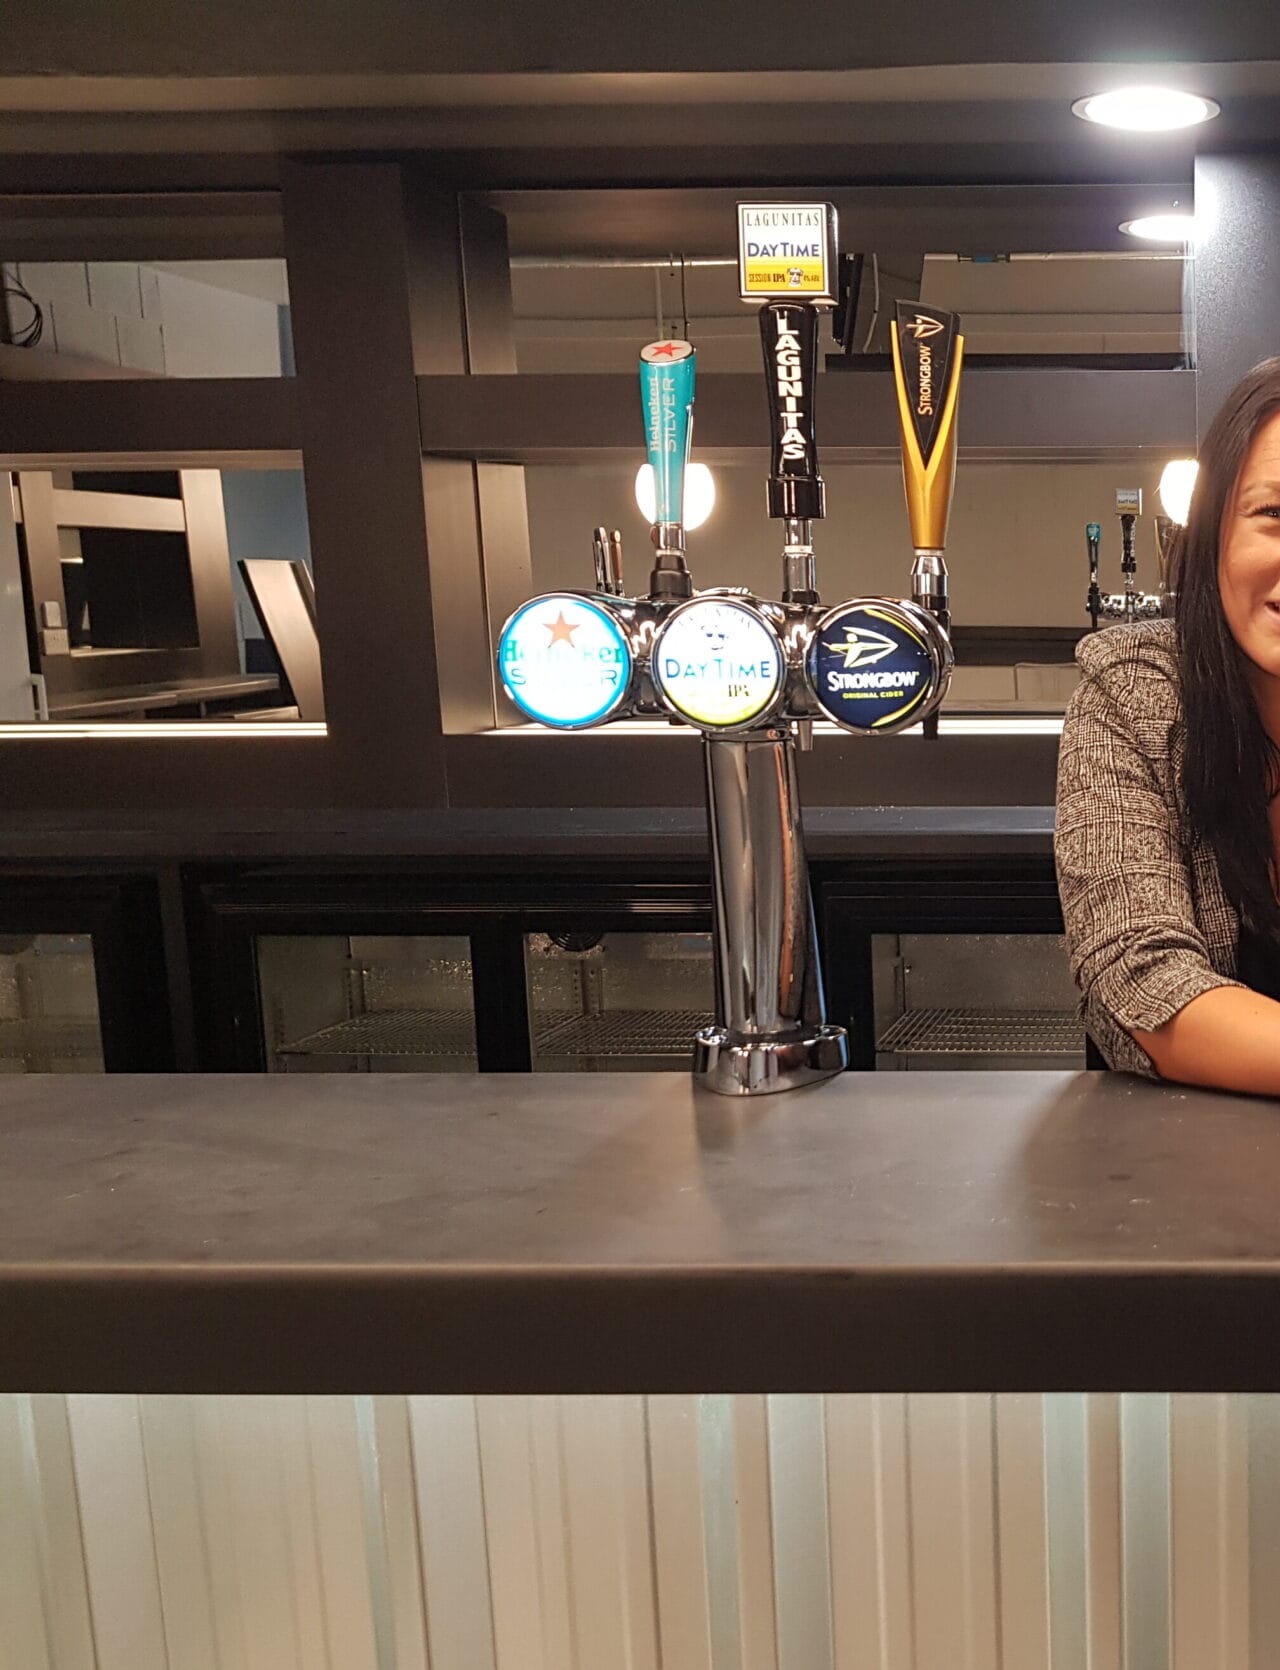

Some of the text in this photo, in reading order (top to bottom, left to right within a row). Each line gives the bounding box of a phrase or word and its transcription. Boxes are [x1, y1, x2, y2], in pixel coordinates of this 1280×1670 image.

[746, 212, 819, 226] LAGUNITAS
[773, 273, 786, 283] IPA
[774, 311, 808, 460] LAGUNITAS
[918, 345, 933, 415] STRONGBOW
[648, 377, 662, 451] Heineken
[662, 377, 677, 453] SILVER
[827, 671, 916, 692] STRONGBOW
[842, 690, 904, 699] ORIGINAL CIDER
